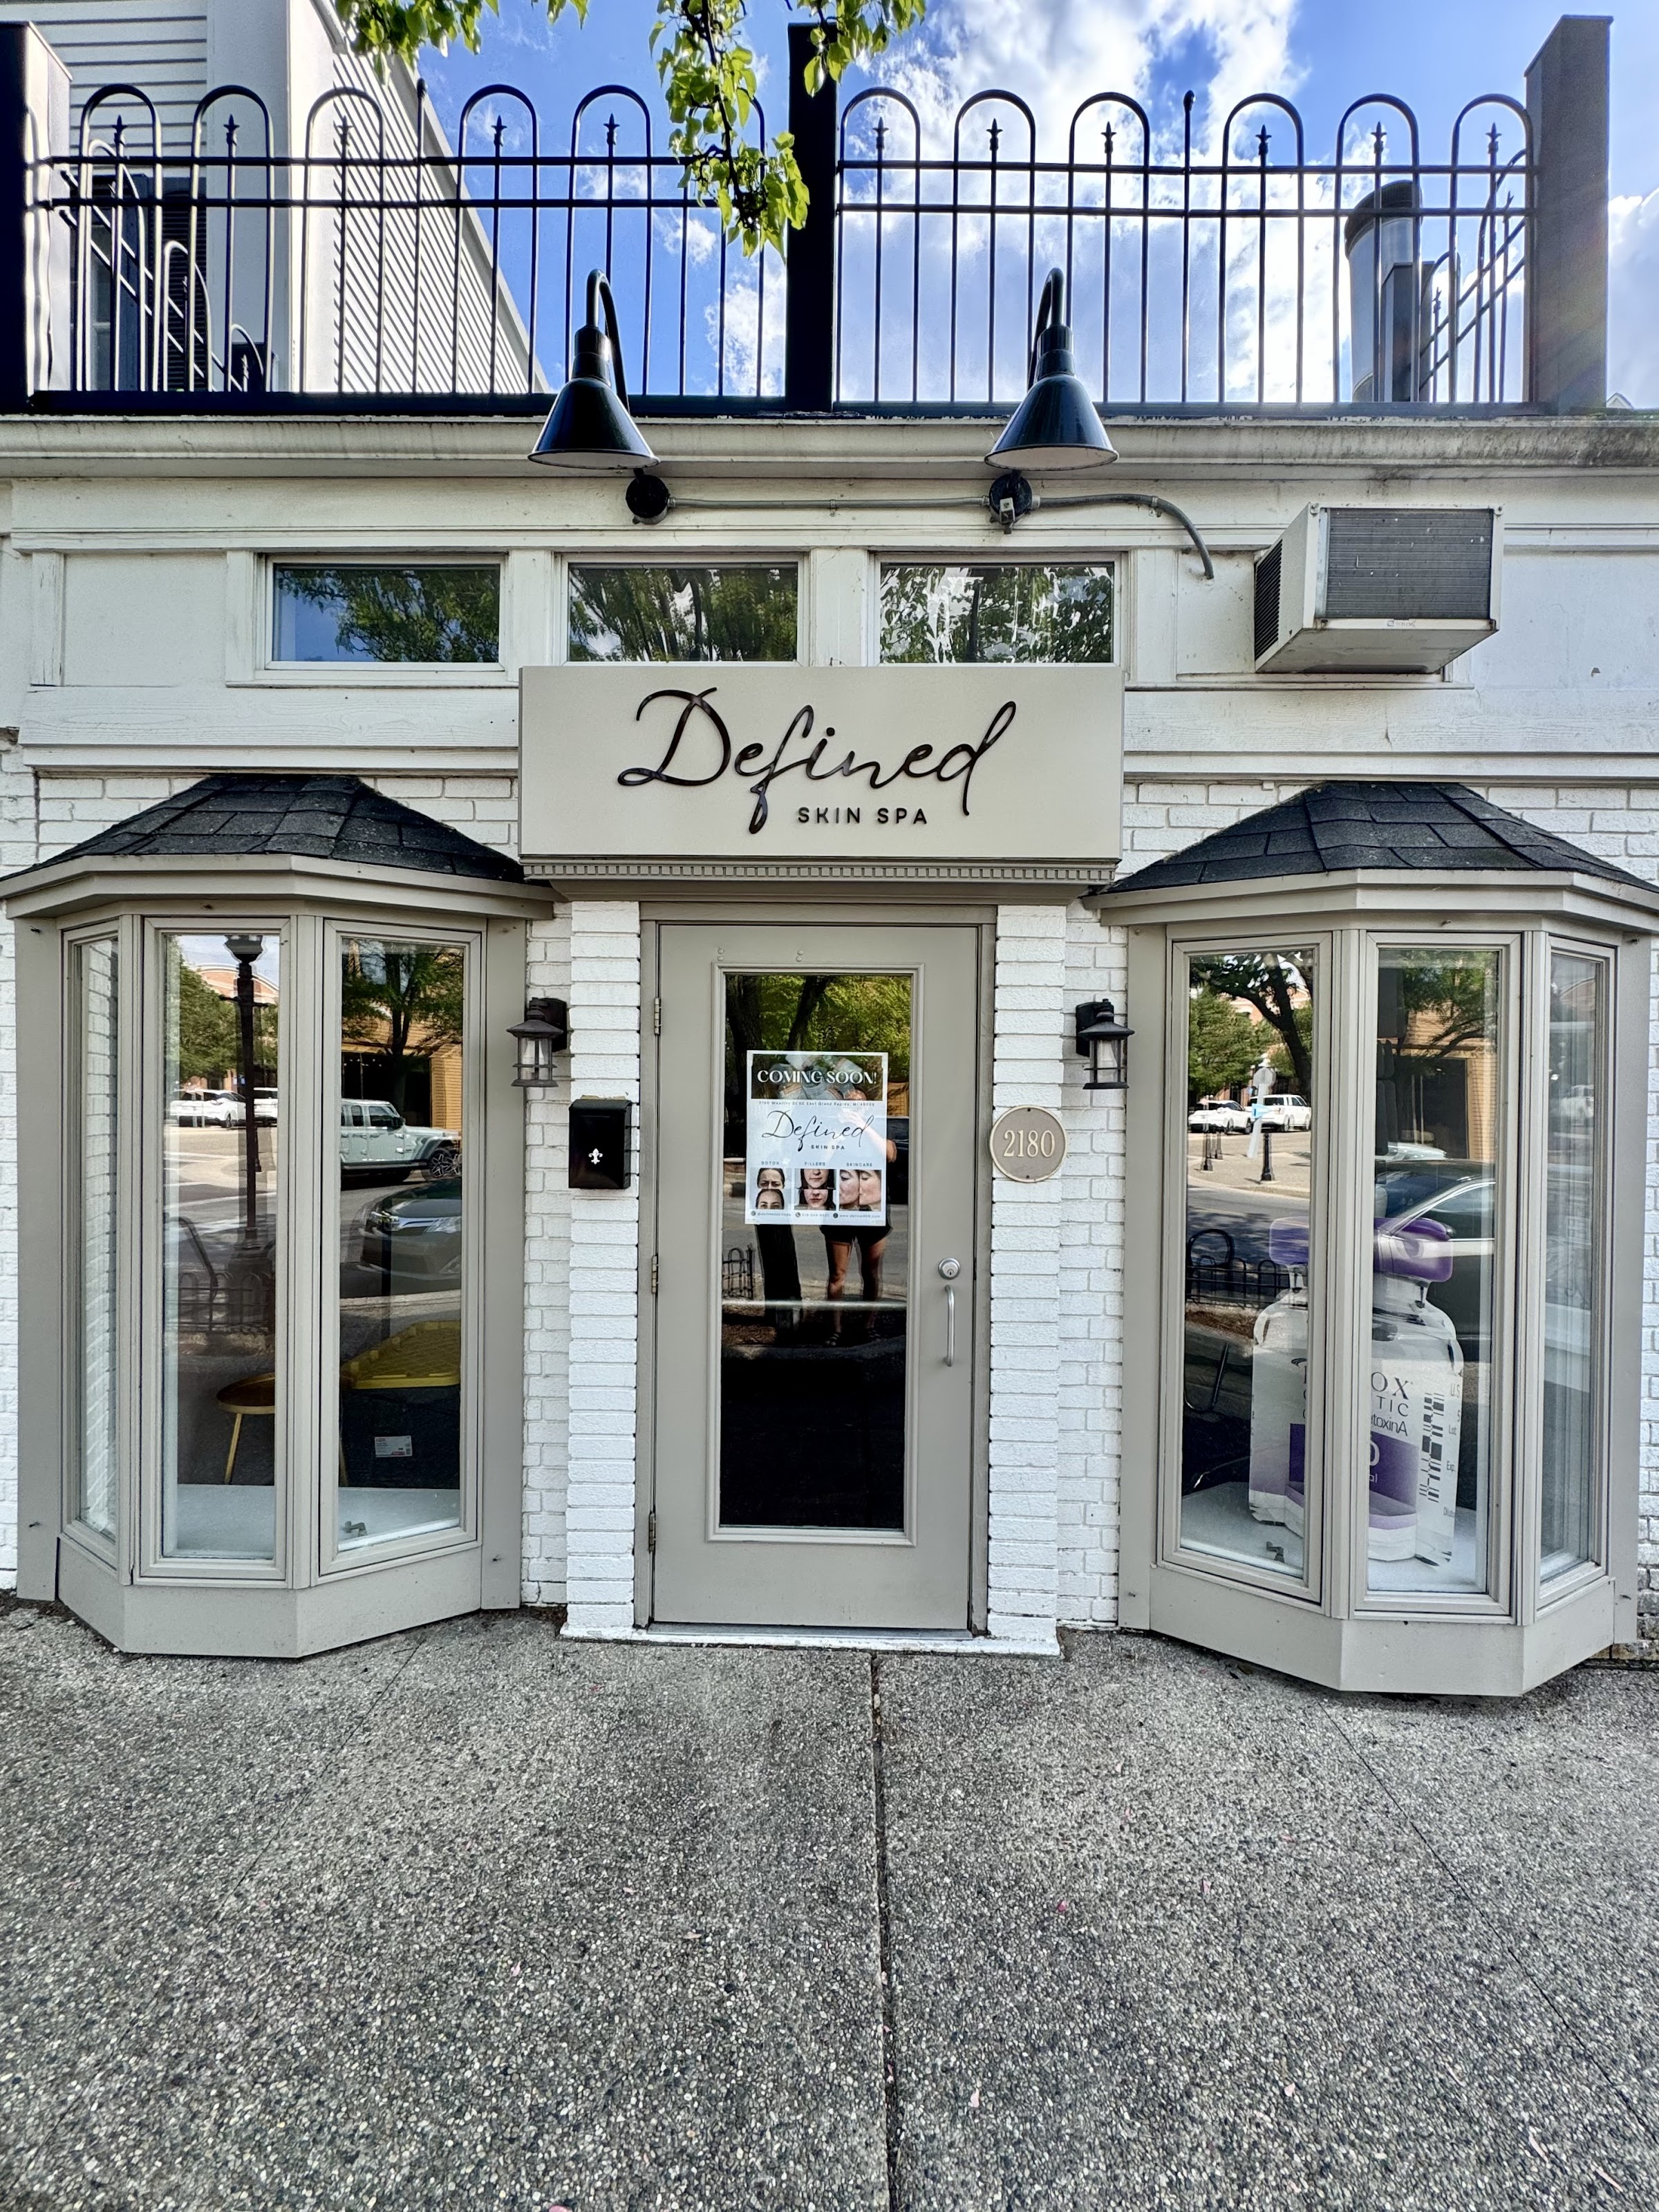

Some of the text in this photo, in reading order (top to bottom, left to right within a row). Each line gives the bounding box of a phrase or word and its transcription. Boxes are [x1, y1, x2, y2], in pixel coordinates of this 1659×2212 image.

[617, 686, 1016, 834] Defined
[797, 806, 928, 825] SKIN SPA
[757, 1070, 877, 1085] COMING SOON!
[762, 1109, 874, 1152] Defined
[1004, 1130, 1056, 1158] 2180
[1371, 1371, 1409, 1400] OX
[1376, 1395, 1409, 1417] TIC
[1371, 1414, 1408, 1436] toxinA
